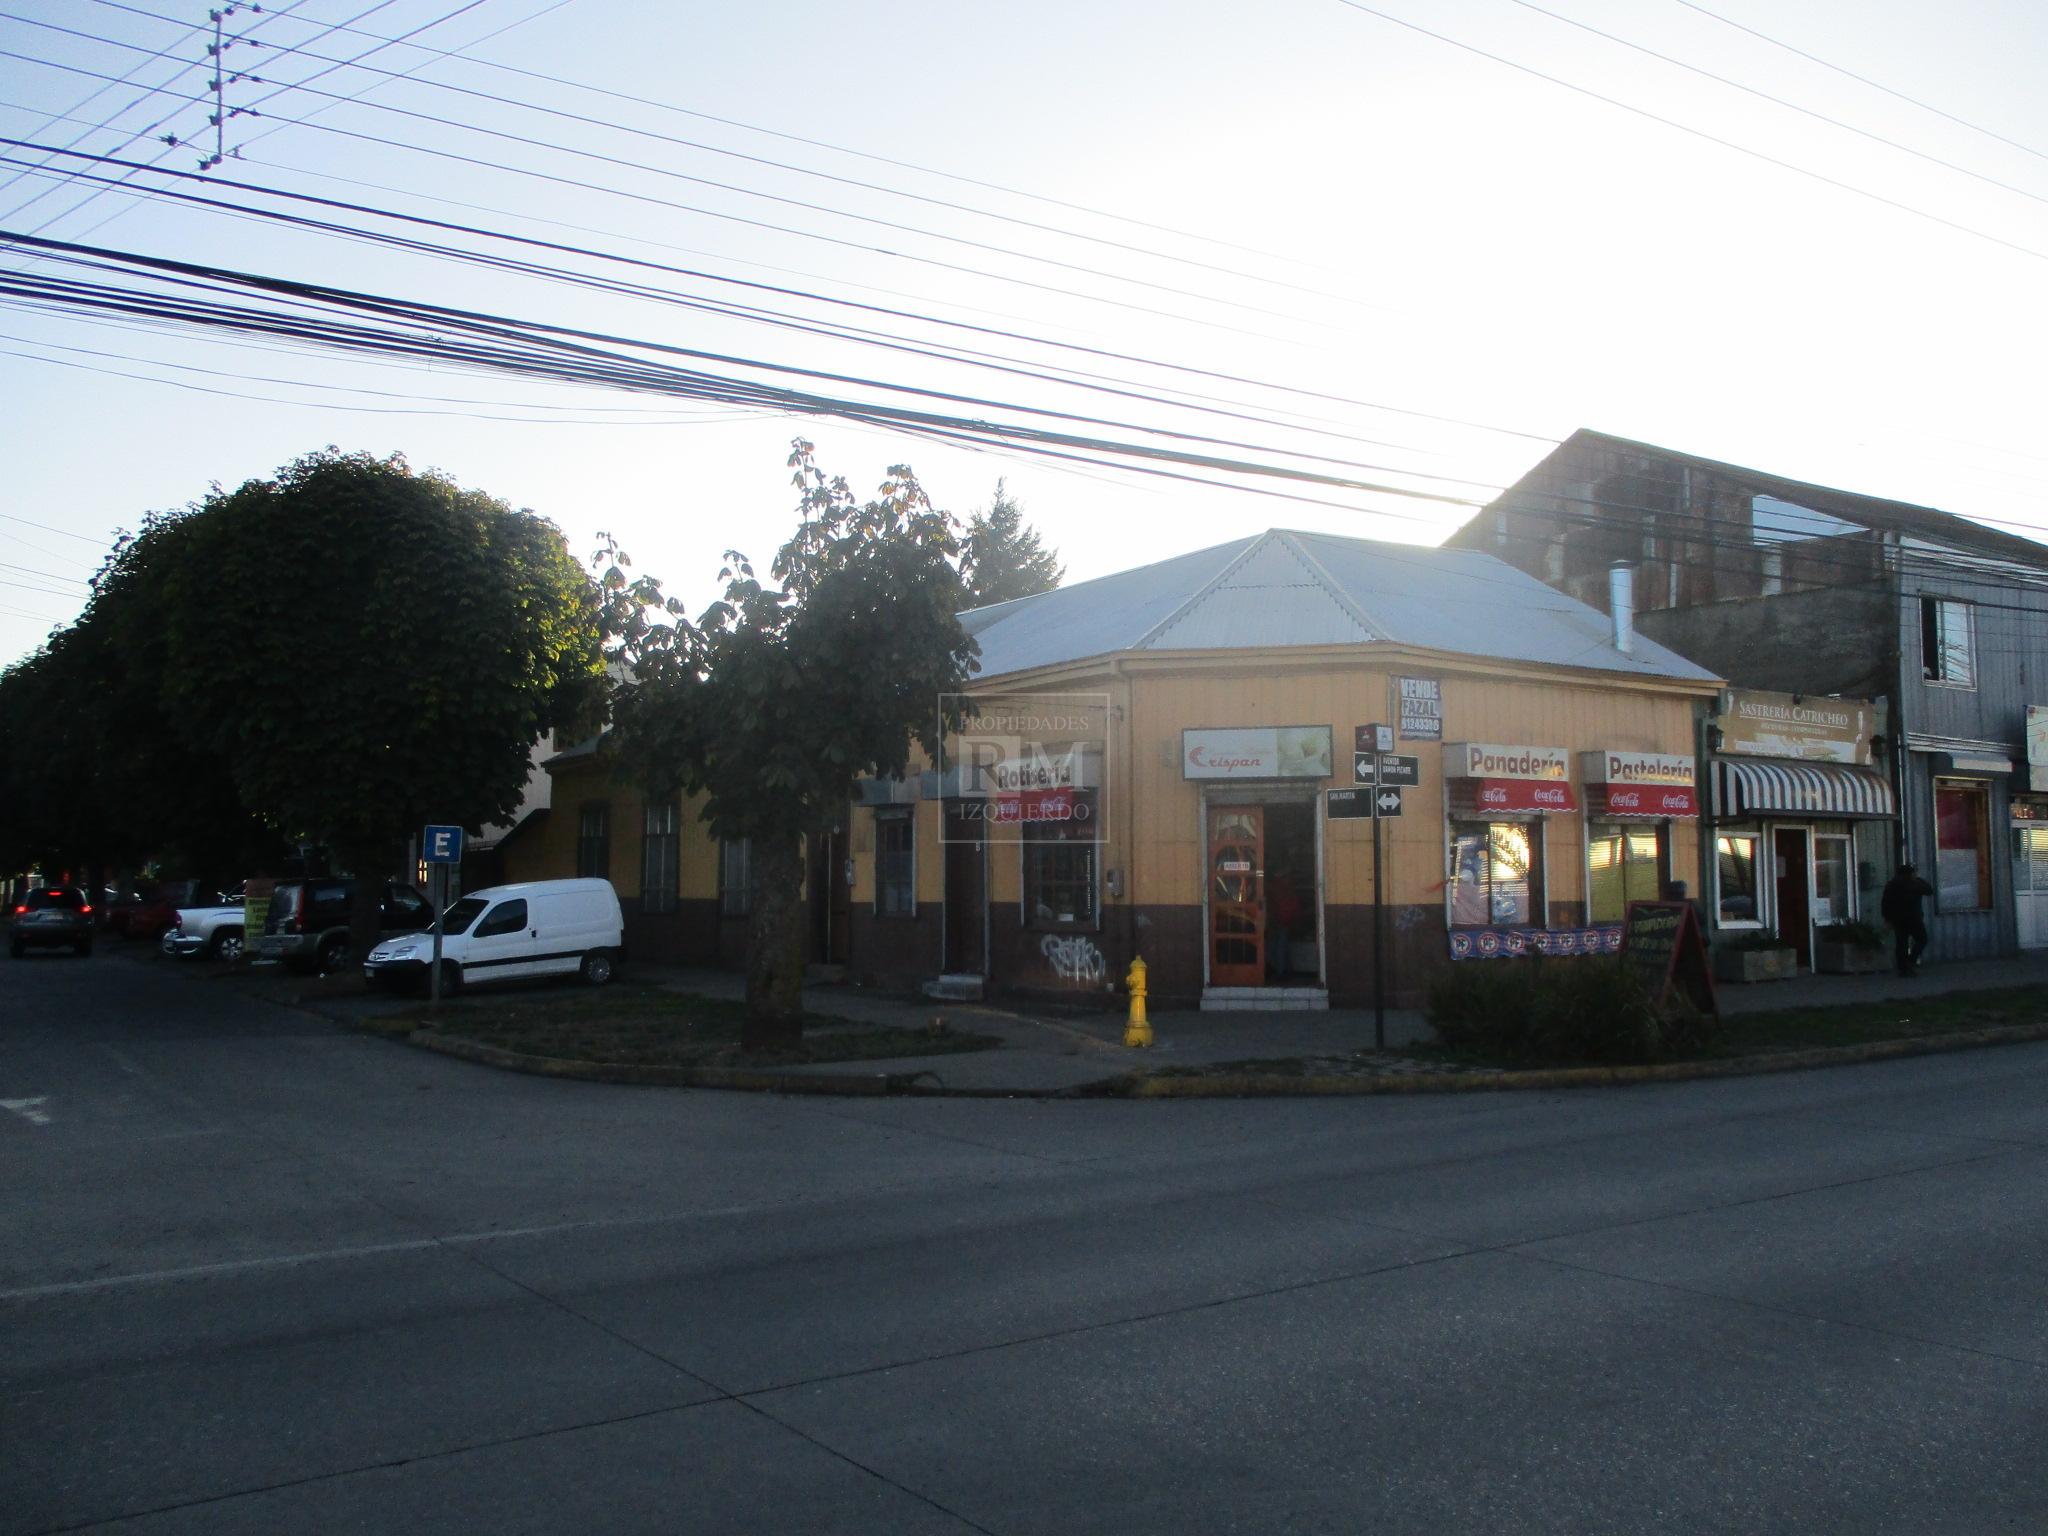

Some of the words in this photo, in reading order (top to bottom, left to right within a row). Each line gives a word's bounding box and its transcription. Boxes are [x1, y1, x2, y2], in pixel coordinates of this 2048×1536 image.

[1400, 679, 1438, 698] VENDE
[1188, 745, 1262, 772] Crispan
[1469, 747, 1565, 776] Panadería
[1609, 756, 1694, 783] Pastelería
[434, 832, 451, 857] E
